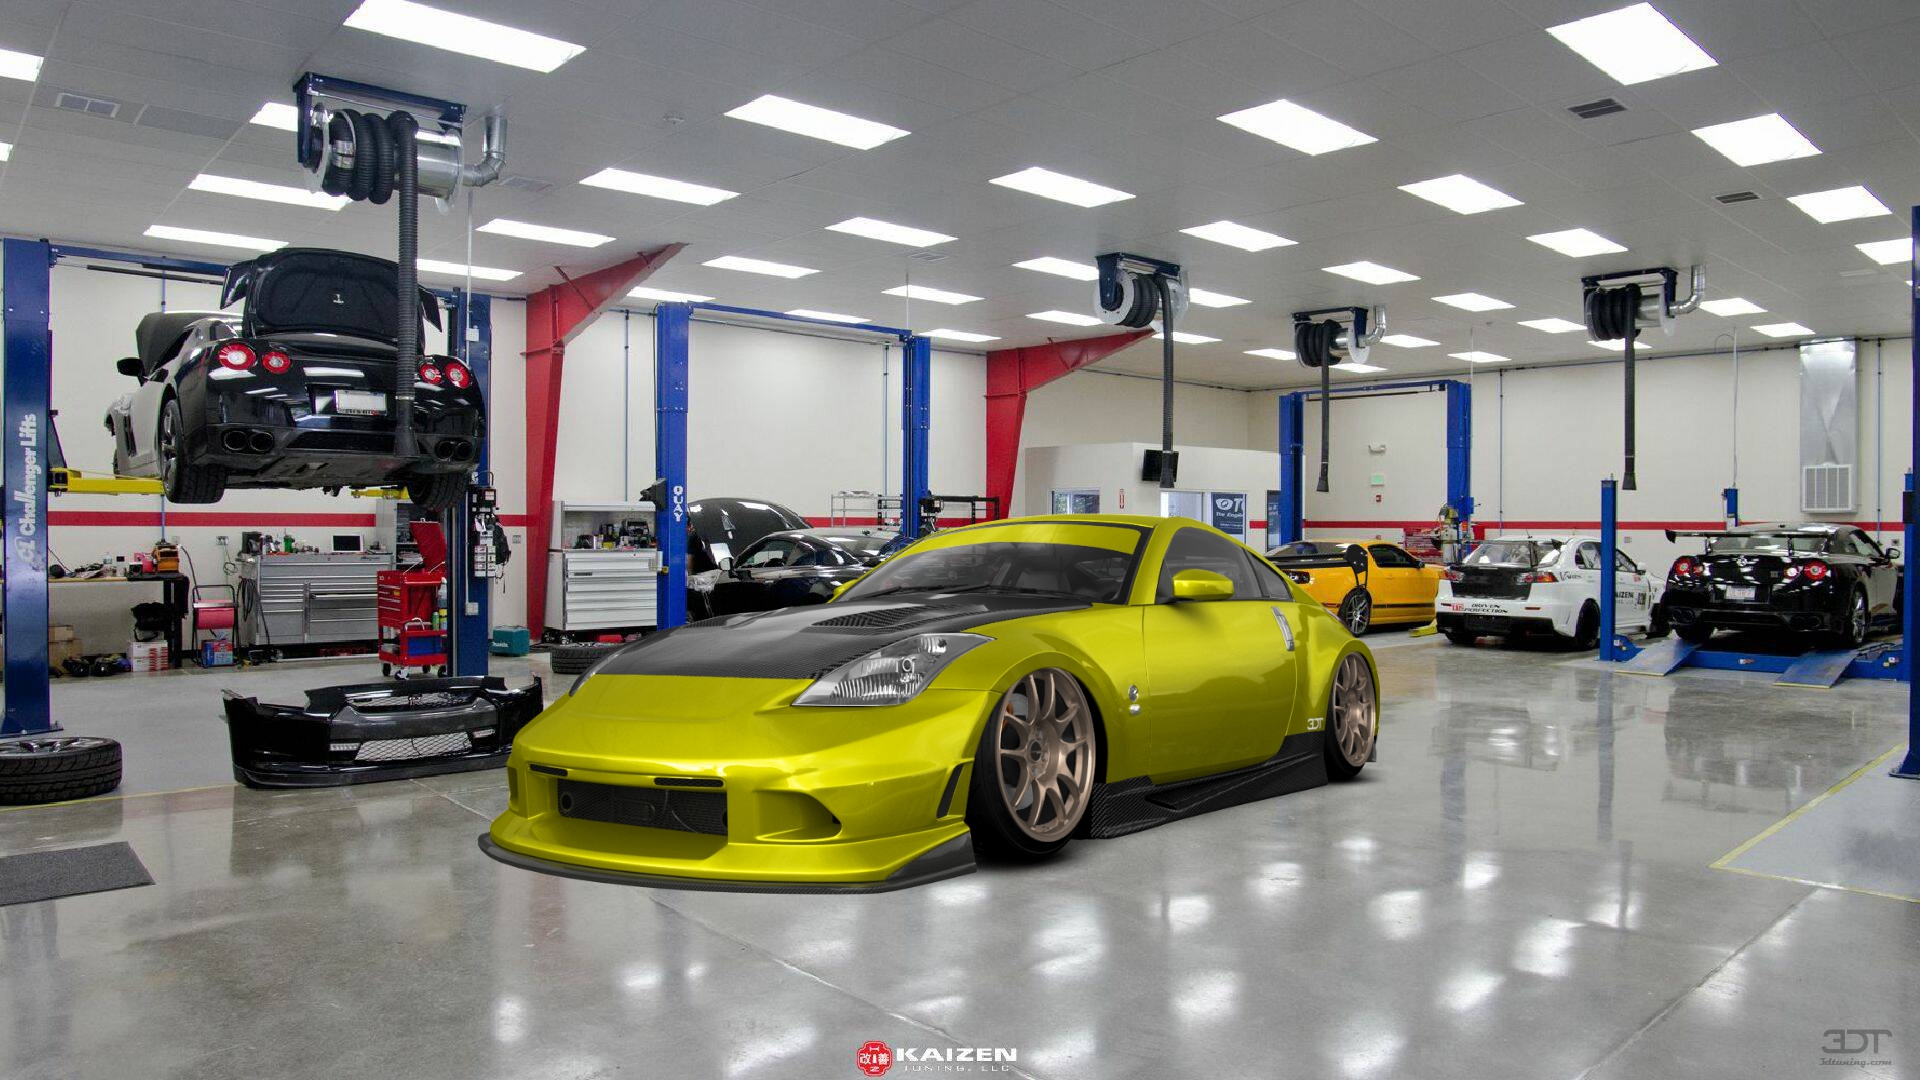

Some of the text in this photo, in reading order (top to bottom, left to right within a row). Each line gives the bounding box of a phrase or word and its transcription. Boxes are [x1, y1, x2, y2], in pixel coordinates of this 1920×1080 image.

[18, 413, 37, 447] Lifts
[14, 447, 42, 536] Challenger
[1615, 591, 1634, 599] AIZEN
[1306, 717, 1324, 731] 3DT
